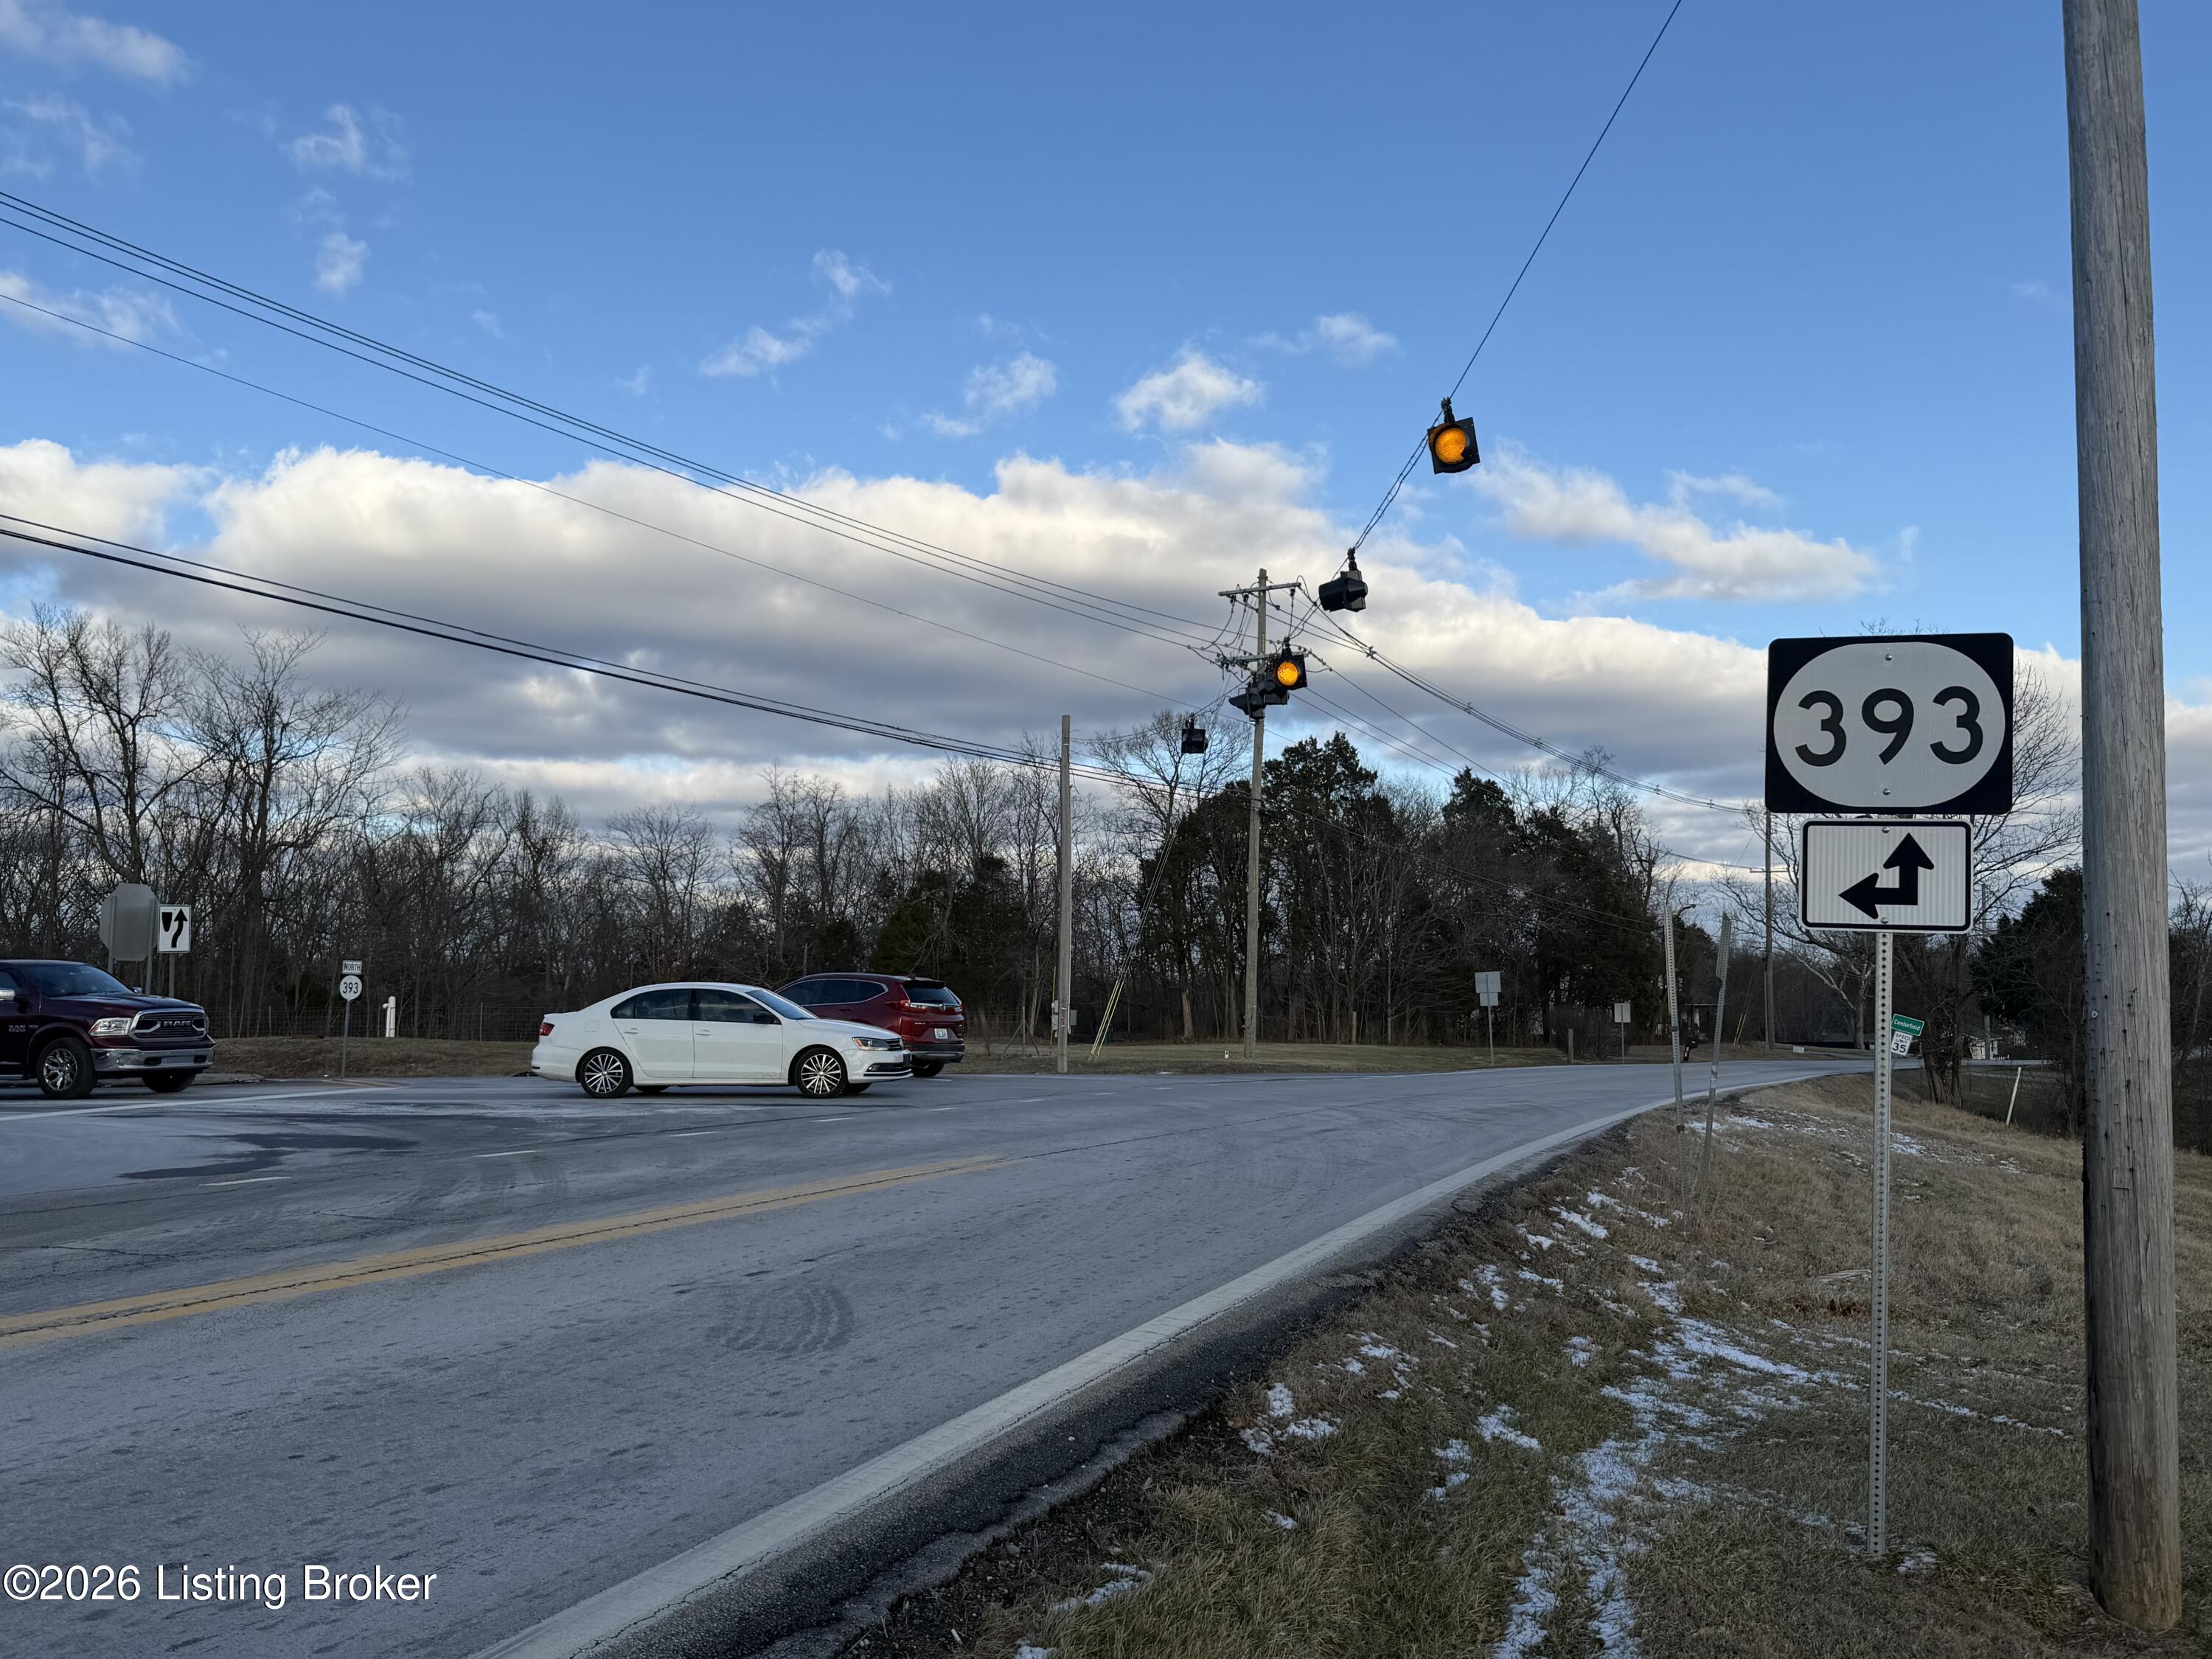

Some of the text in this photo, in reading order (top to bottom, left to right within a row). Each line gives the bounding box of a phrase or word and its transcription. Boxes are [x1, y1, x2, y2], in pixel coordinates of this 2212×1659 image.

[1795, 686, 1983, 767] 393
[344, 963, 361, 971] NORTH
[343, 982, 358, 994] 393
[1893, 1019, 1921, 1031] Centerfield
[1892, 1043, 1906, 1053] 35
